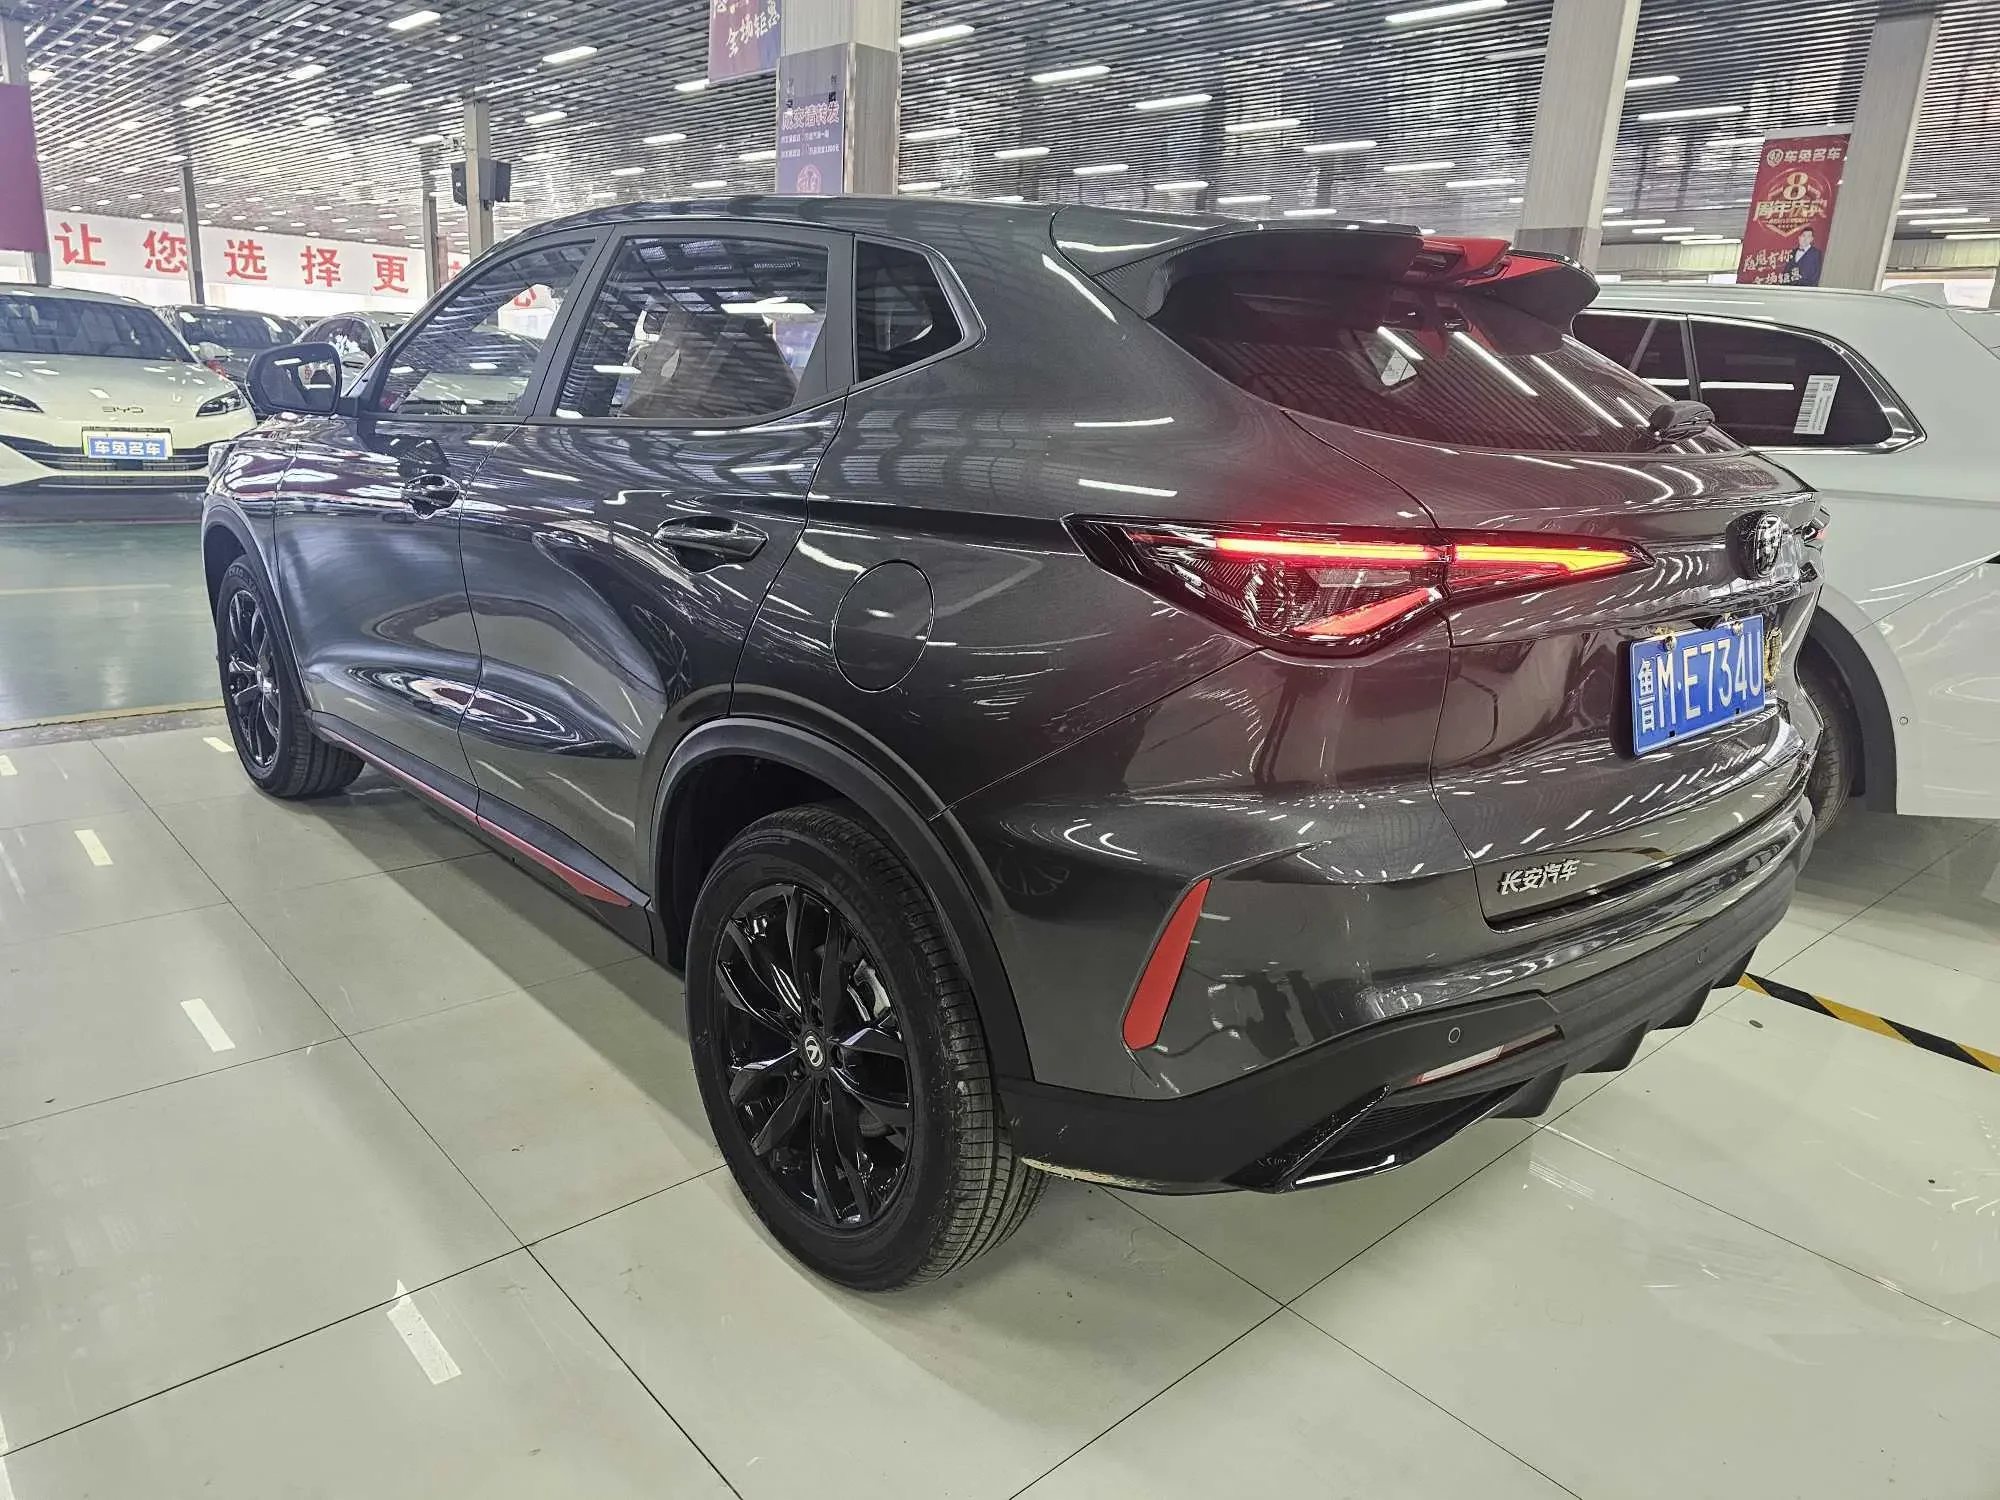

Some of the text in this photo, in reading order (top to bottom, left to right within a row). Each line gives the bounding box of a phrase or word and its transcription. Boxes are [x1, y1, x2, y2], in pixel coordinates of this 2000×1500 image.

[1783, 172, 1808, 200] 8
[1501, 858, 1580, 895] 长安汽车
